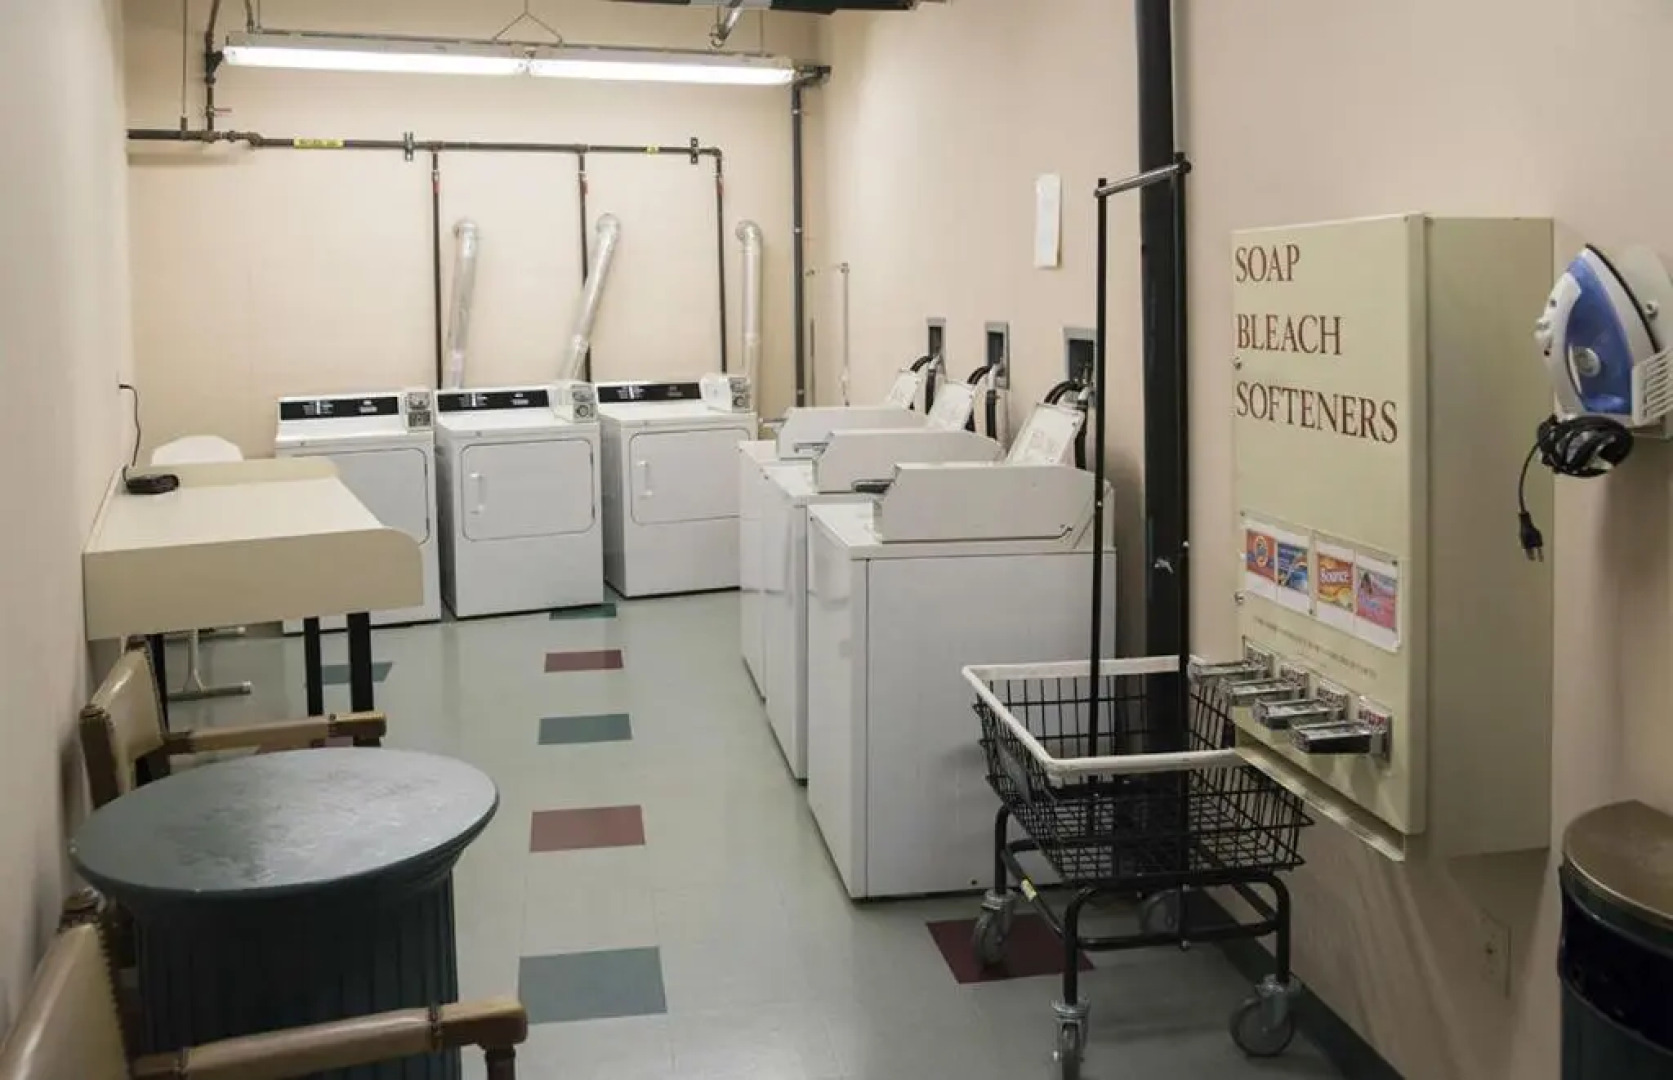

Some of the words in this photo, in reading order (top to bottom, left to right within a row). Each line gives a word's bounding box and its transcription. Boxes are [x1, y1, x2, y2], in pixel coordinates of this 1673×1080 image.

[1235, 244, 1300, 283] SOAP
[1237, 313, 1342, 356] BLEACH
[1236, 380, 1398, 444] SOFTENERS
